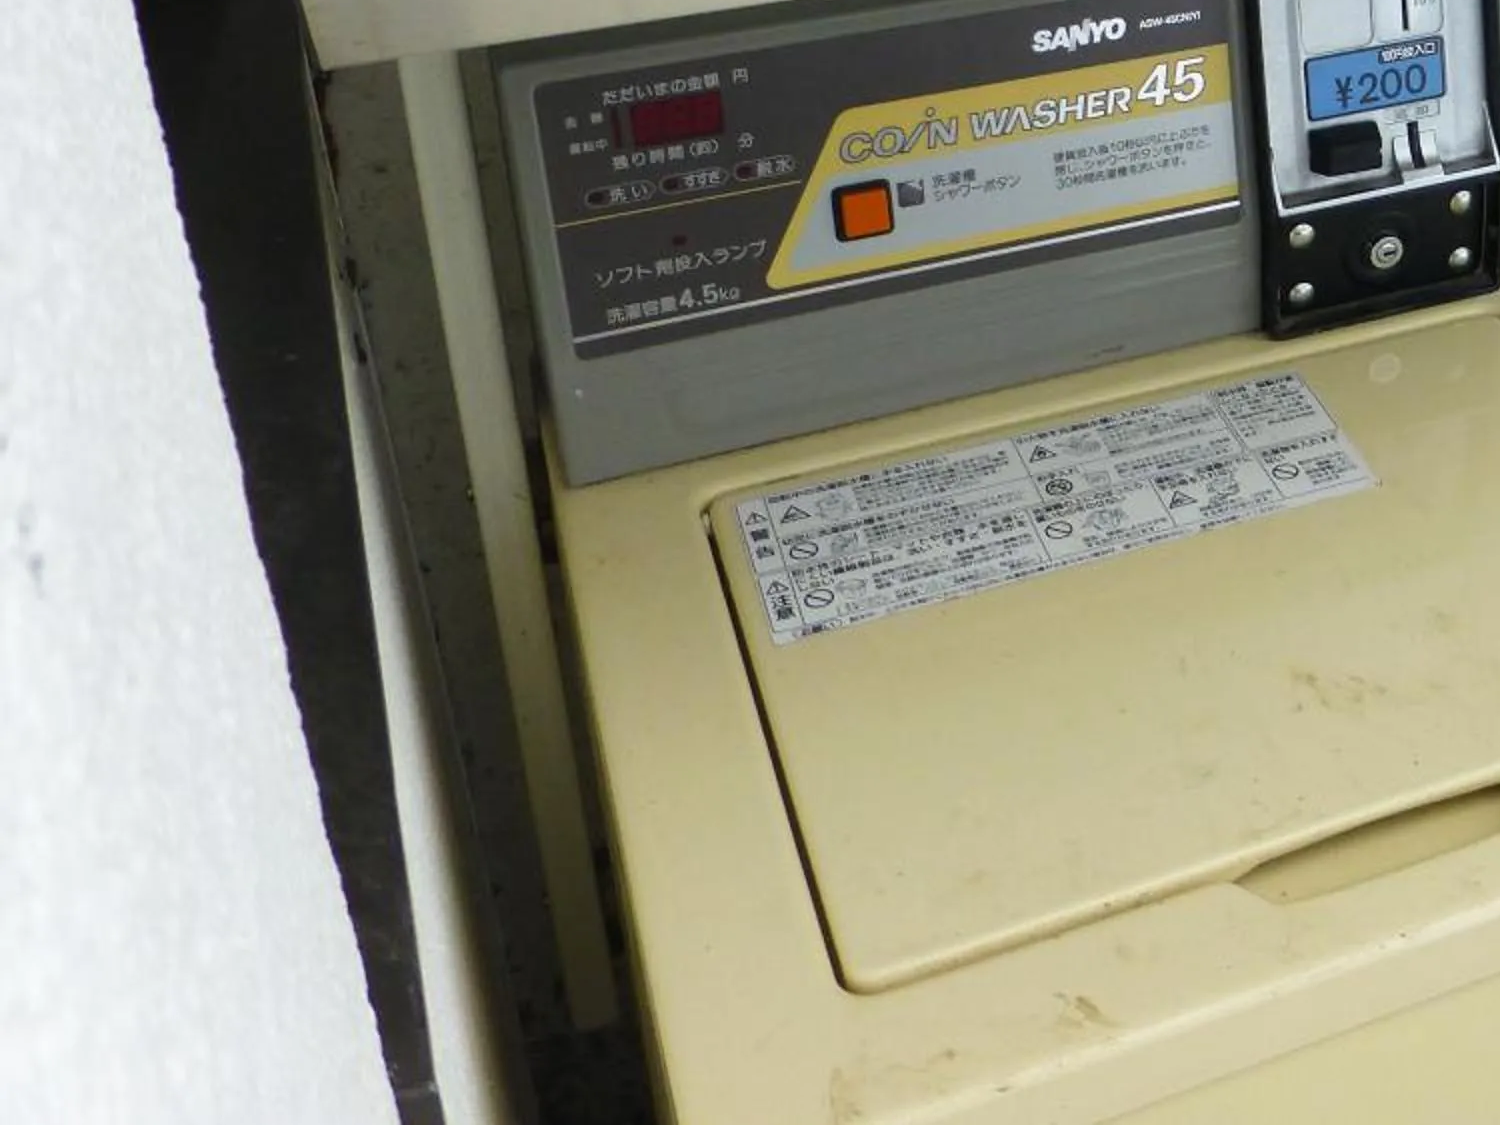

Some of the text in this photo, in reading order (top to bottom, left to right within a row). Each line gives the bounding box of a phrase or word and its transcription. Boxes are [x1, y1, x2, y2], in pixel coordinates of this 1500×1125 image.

[1031, 16, 1128, 53] SANYO
[602, 67, 750, 106] ただいまの金額 円
[1333, 63, 1428, 109] ¥200
[839, 55, 1207, 164] COIN WASHER 45
[736, 131, 755, 150] 分
